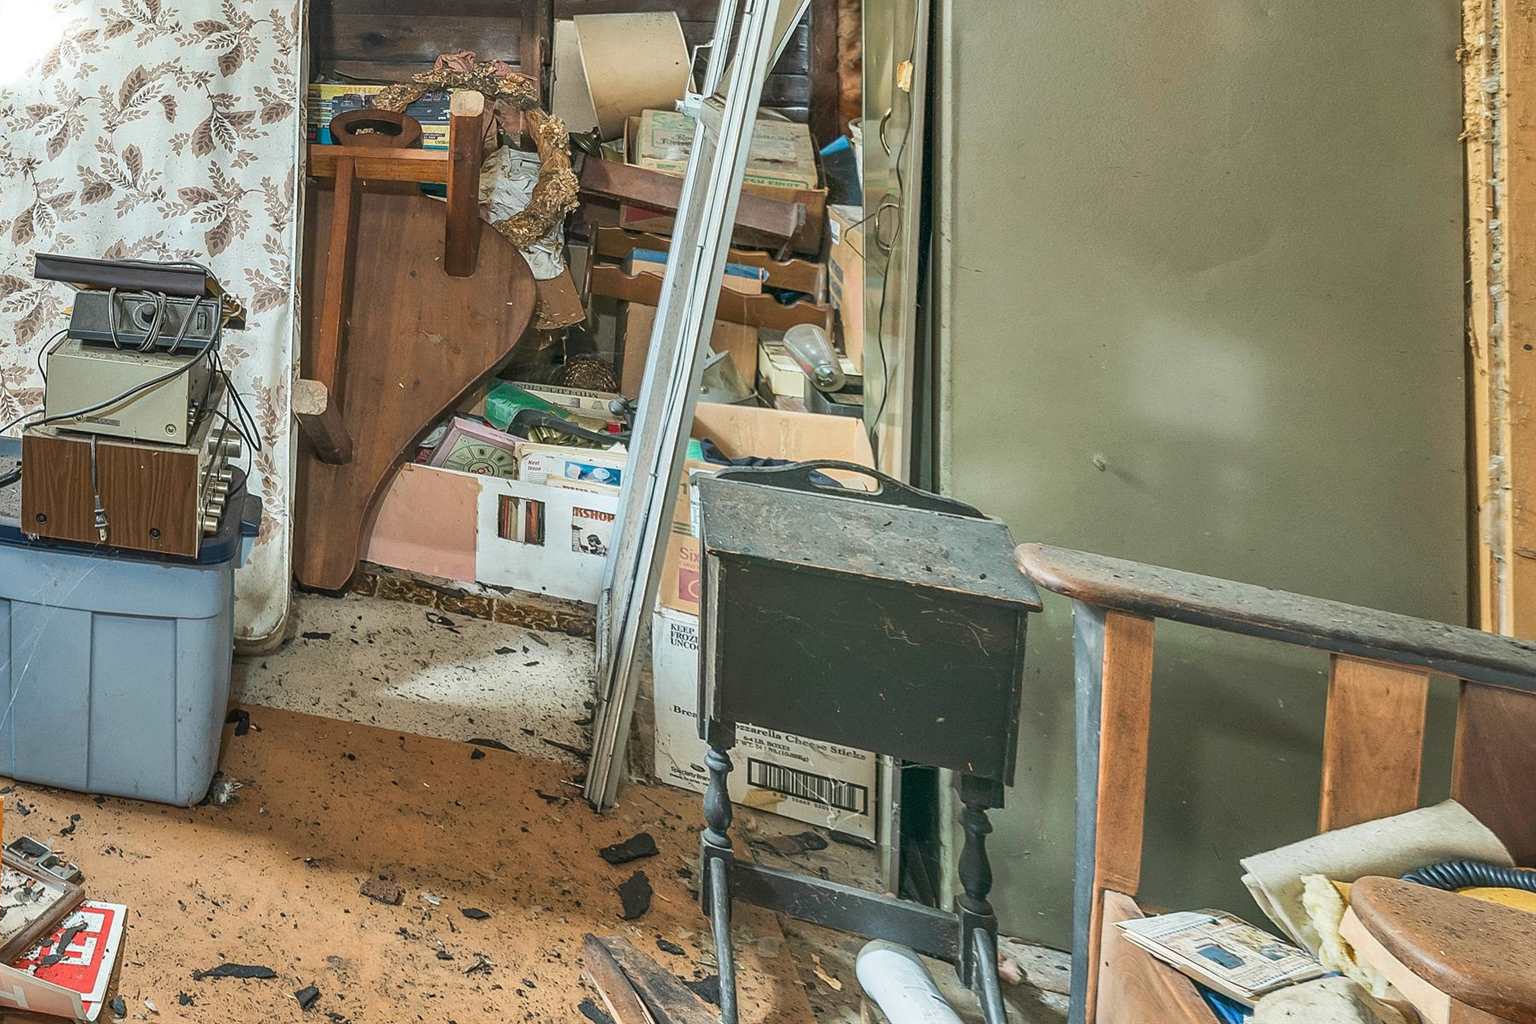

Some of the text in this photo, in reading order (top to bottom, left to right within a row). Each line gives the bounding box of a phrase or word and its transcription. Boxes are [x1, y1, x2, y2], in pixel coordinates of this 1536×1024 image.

[671, 623, 695, 634] KEEP
[671, 631, 698, 644] FROZ
[671, 638, 698, 651] UNCO
[830, 745, 866, 761] Sticks
